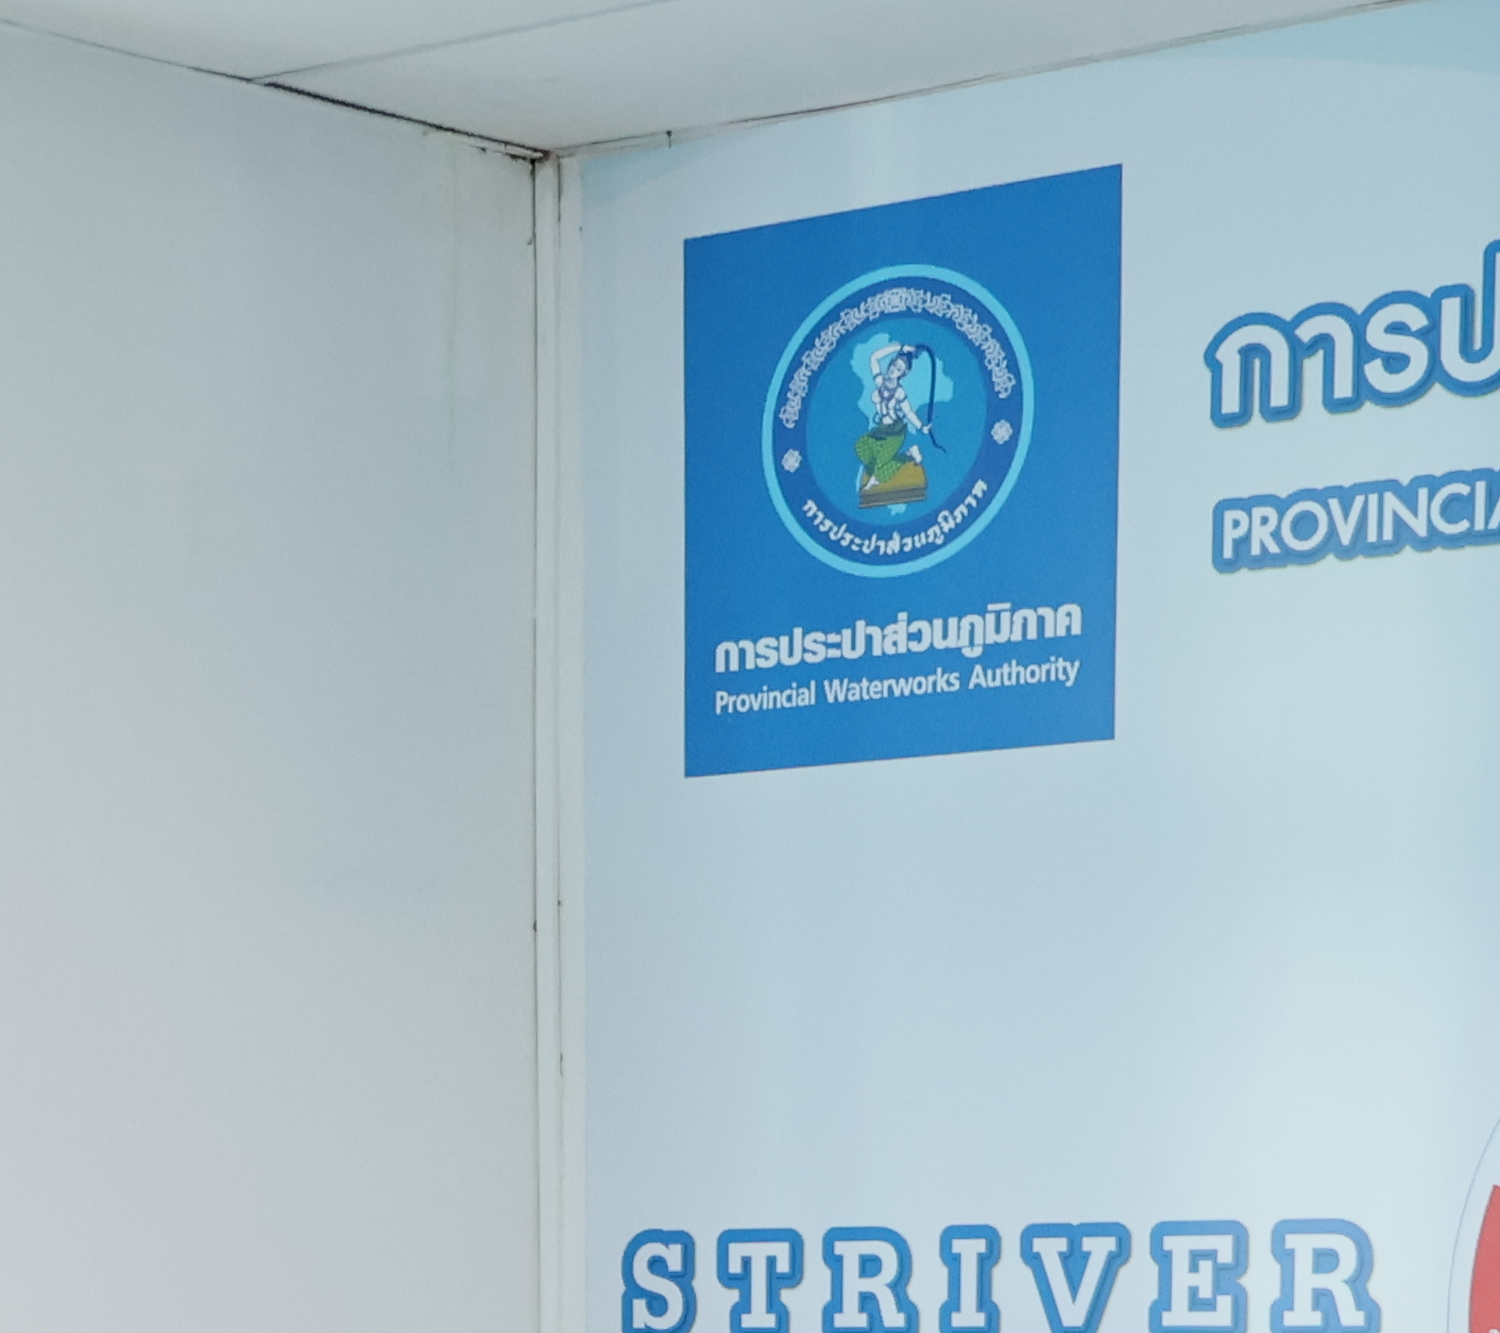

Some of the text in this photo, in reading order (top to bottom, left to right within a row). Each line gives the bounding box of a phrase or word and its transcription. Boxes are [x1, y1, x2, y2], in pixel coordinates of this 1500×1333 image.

[715, 602, 1083, 673] การประปาส่วนภูมิภาค
[715, 656, 1081, 715] Provincial Waterworks Authority
